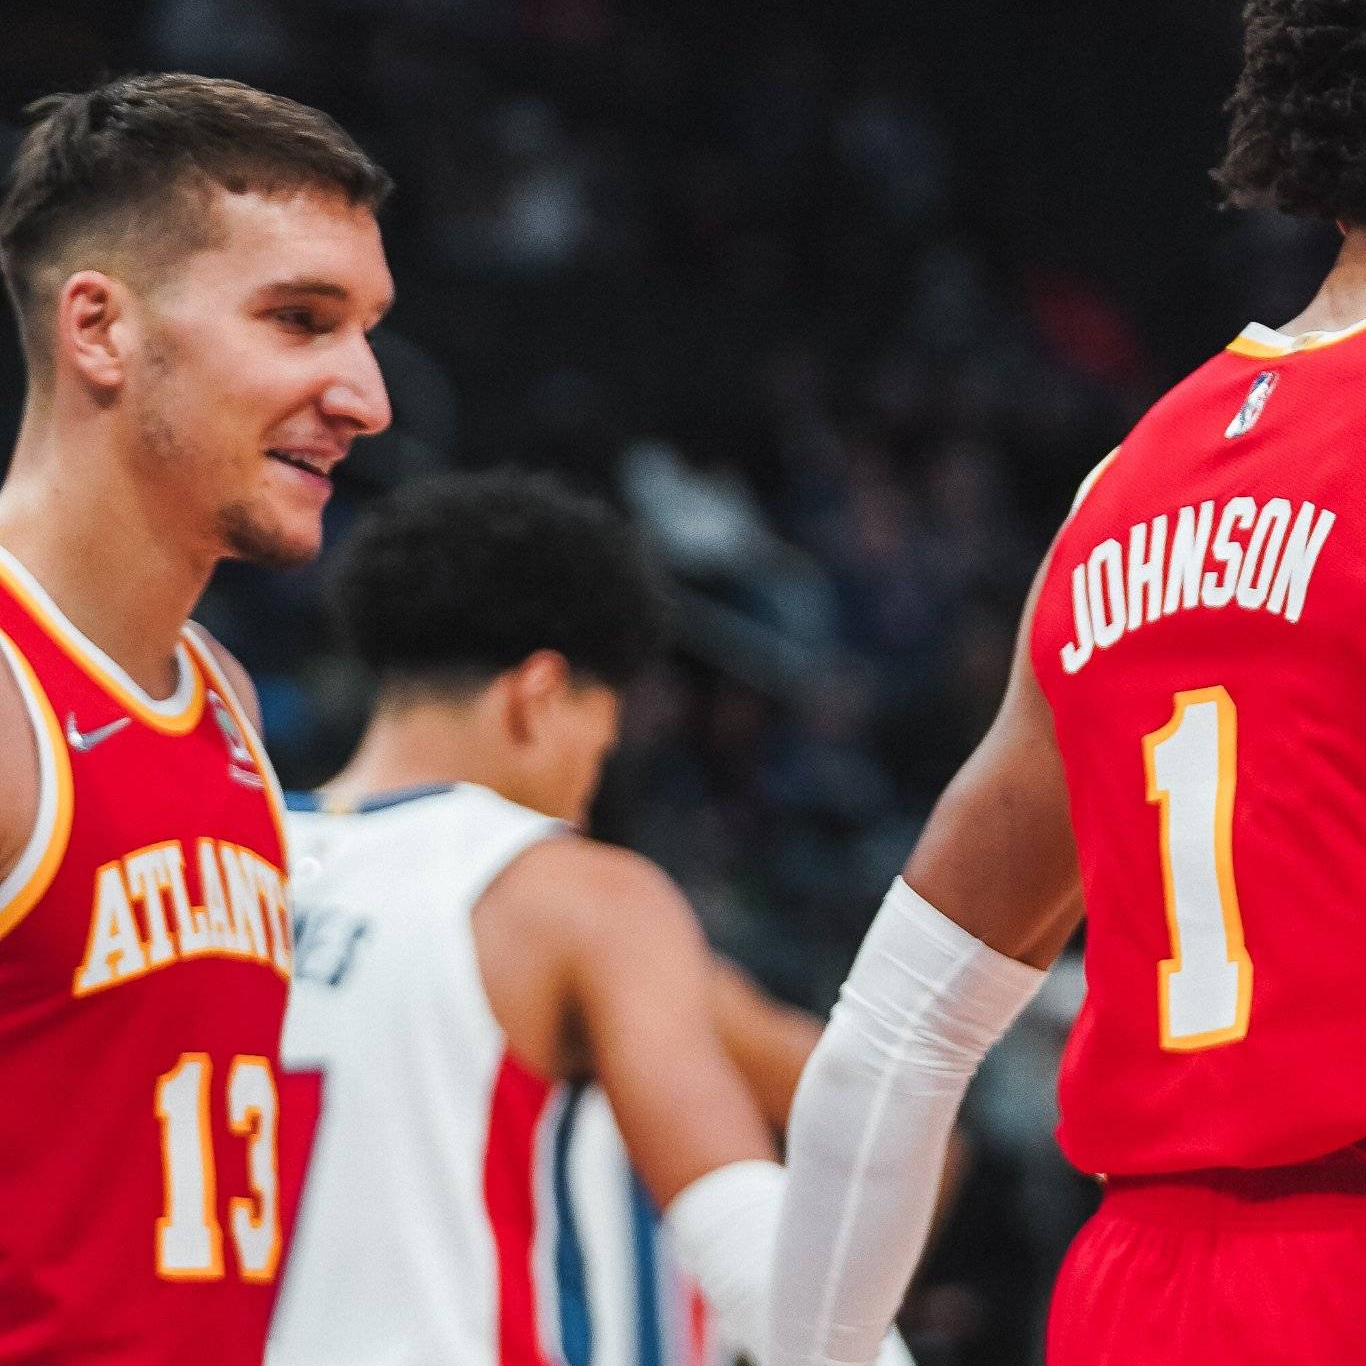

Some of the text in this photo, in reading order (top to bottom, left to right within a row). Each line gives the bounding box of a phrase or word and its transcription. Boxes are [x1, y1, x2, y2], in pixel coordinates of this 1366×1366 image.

[1060, 496, 1336, 674] JOHNSON
[72, 836, 290, 998] ATLANT
[1142, 685, 1253, 1051] 1
[154, 1052, 279, 1285] 13
